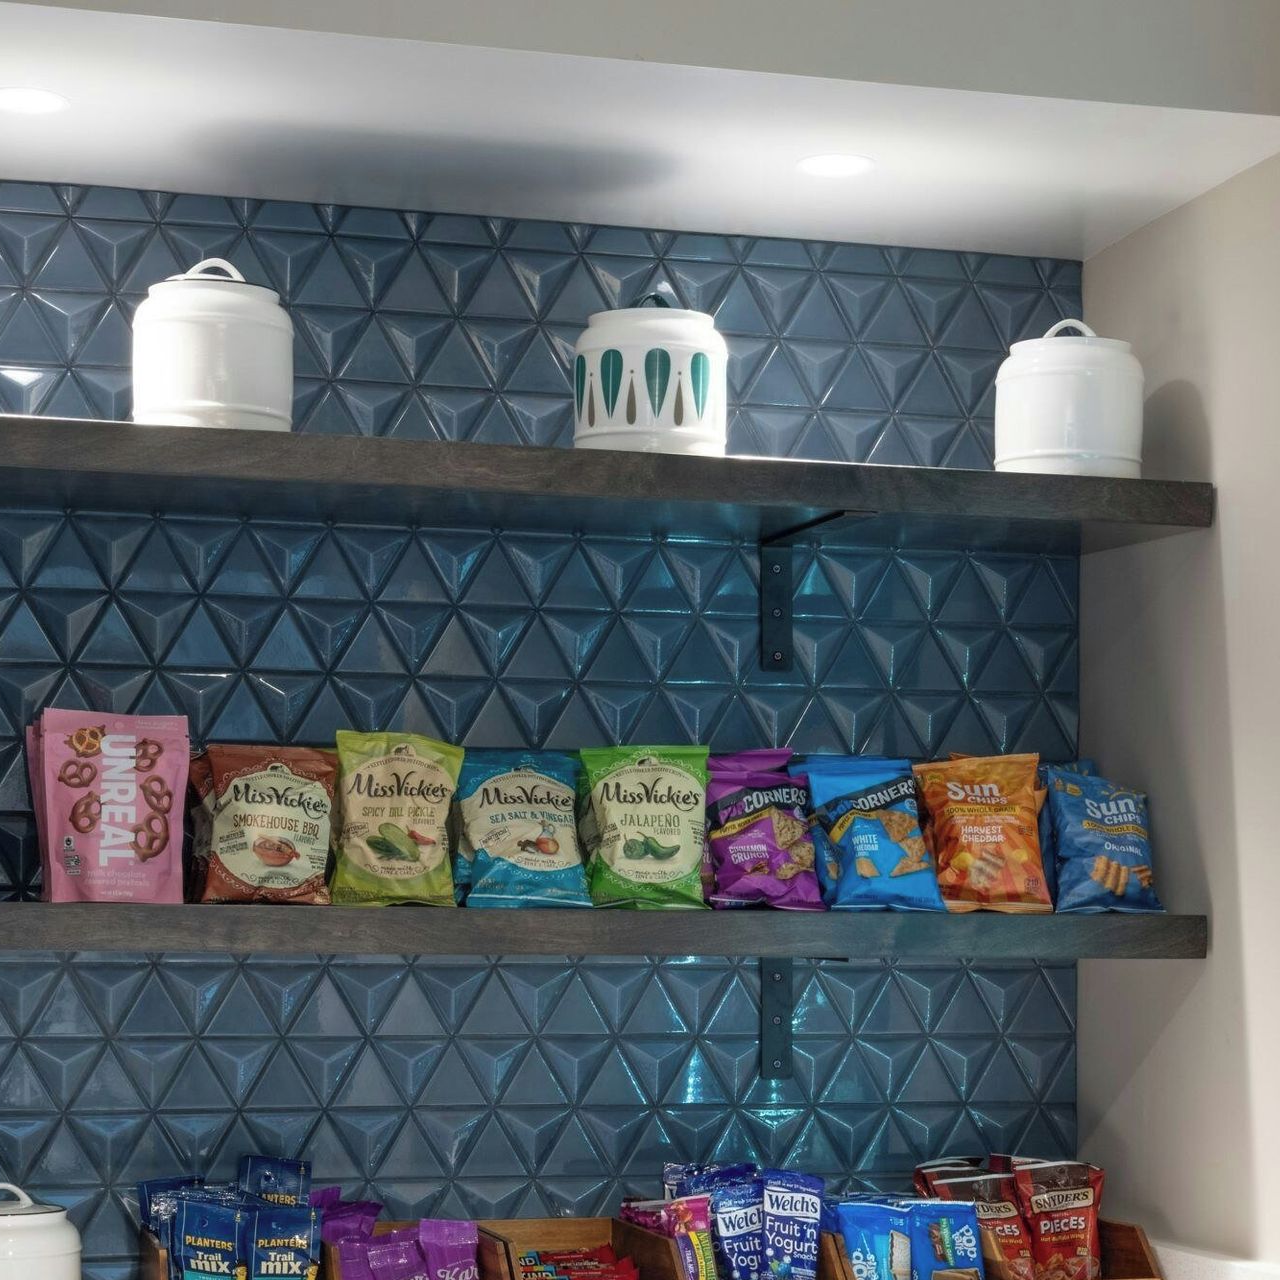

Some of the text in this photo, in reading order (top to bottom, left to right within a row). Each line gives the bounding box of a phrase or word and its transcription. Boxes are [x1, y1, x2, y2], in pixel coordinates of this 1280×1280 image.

[946, 782, 1001, 801] Sun
[100, 735, 136, 866] UNREAL
[967, 796, 1008, 805] CHIPS
[362, 807, 435, 817] SPICY DILL PICKLE
[1085, 799, 1136, 819] Sun
[489, 815, 507, 824] SEA
[508, 811, 528, 820] SALT
[233, 814, 320, 840] SMOKEHOUSE BBQ
[654, 828, 681, 836] FLAVORED
[961, 826, 1003, 835] HARVEST
[852, 835, 878, 844] WHITE
[961, 834, 1006, 843] CHEDDAR
[729, 844, 767, 853] CINNAMON
[731, 851, 769, 864] CRUNCH
[768, 1193, 818, 1214] Welch's
[1035, 1191, 1090, 1209] SNYDER'S
[766, 1216, 800, 1236] Fruit
[1039, 1217, 1086, 1234] PIECES
[185, 1235, 234, 1251] PLANTERS
[258, 1236, 308, 1249] PLANTERS
[723, 1238, 761, 1254] Fruit
[766, 1231, 818, 1254] Yogurt
[196, 1251, 222, 1261] Trail
[269, 1252, 294, 1262] Trail
[191, 1259, 231, 1274] mix
[260, 1261, 302, 1275] mix
